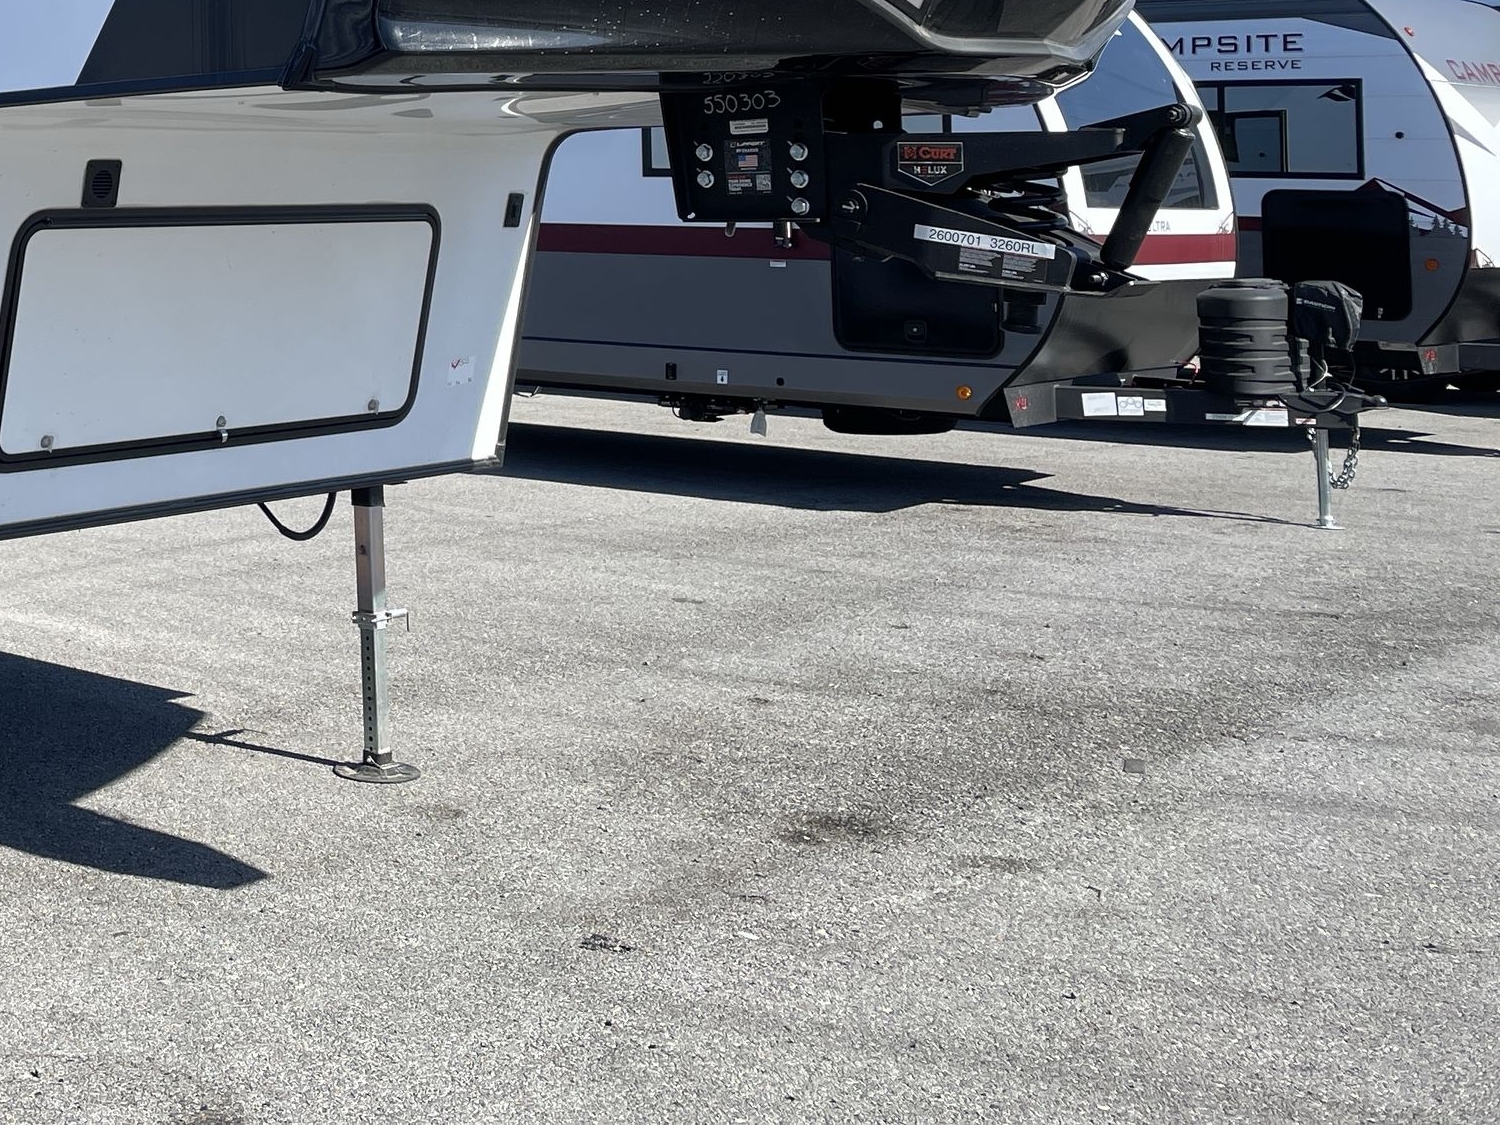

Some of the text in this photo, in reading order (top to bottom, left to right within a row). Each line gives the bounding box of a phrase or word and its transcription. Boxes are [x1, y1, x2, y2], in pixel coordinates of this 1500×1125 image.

[1160, 33, 1304, 55] MPSITE
[1210, 59, 1303, 72] RESERVE
[703, 90, 781, 114] 550303
[918, 146, 957, 159] CURT
[913, 165, 948, 175] HELUX
[1147, 220, 1171, 233] LTRA
[929, 228, 1039, 255] 2600701 3260RL
